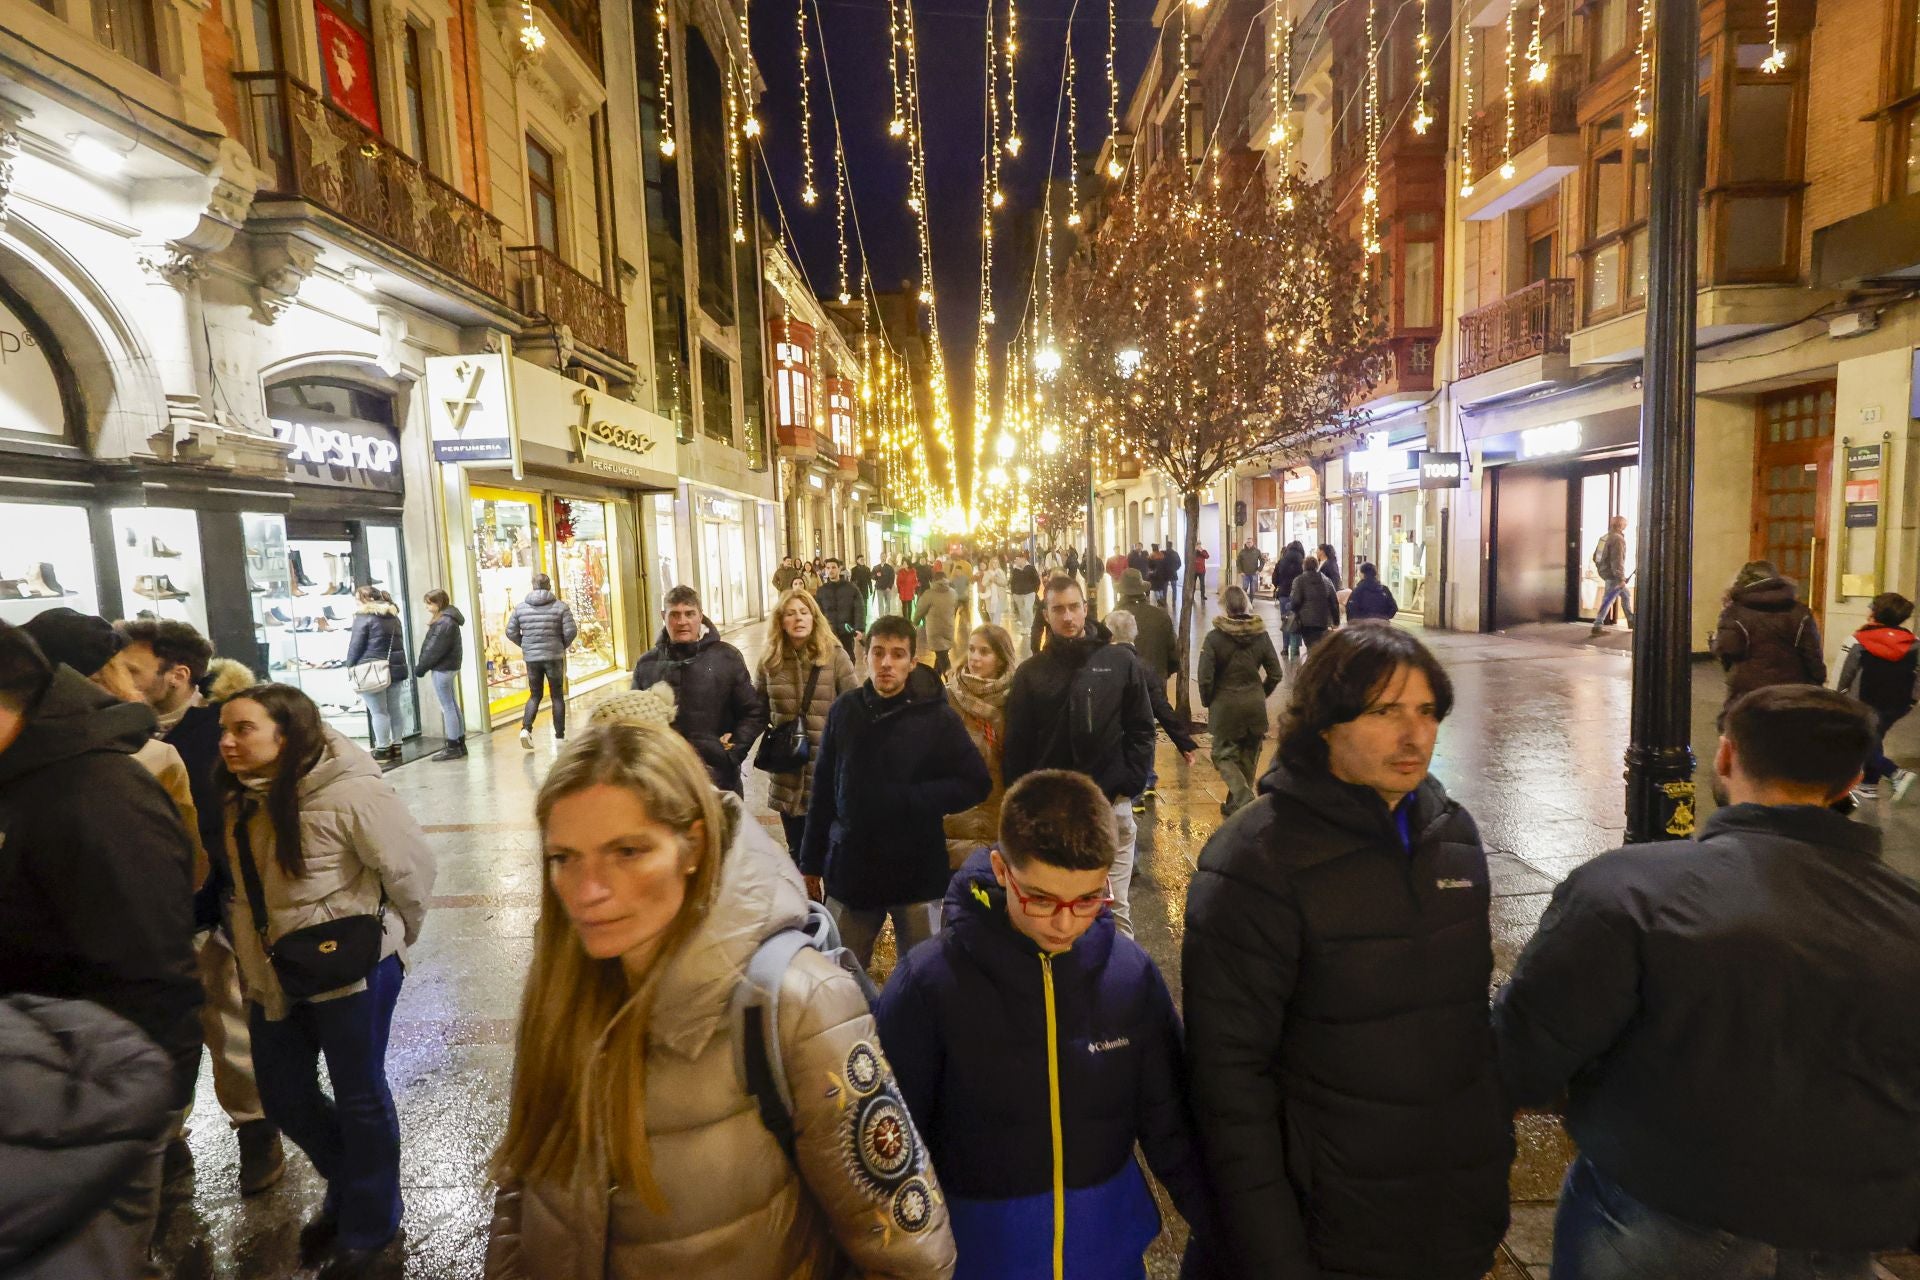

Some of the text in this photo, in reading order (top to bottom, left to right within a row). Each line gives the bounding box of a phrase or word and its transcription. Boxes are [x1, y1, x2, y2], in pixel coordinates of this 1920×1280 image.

[440, 444, 502, 453] PERFUMERIA
[592, 460, 641, 477] PERFUMERIA
[1423, 463, 1459, 478] TOUS
